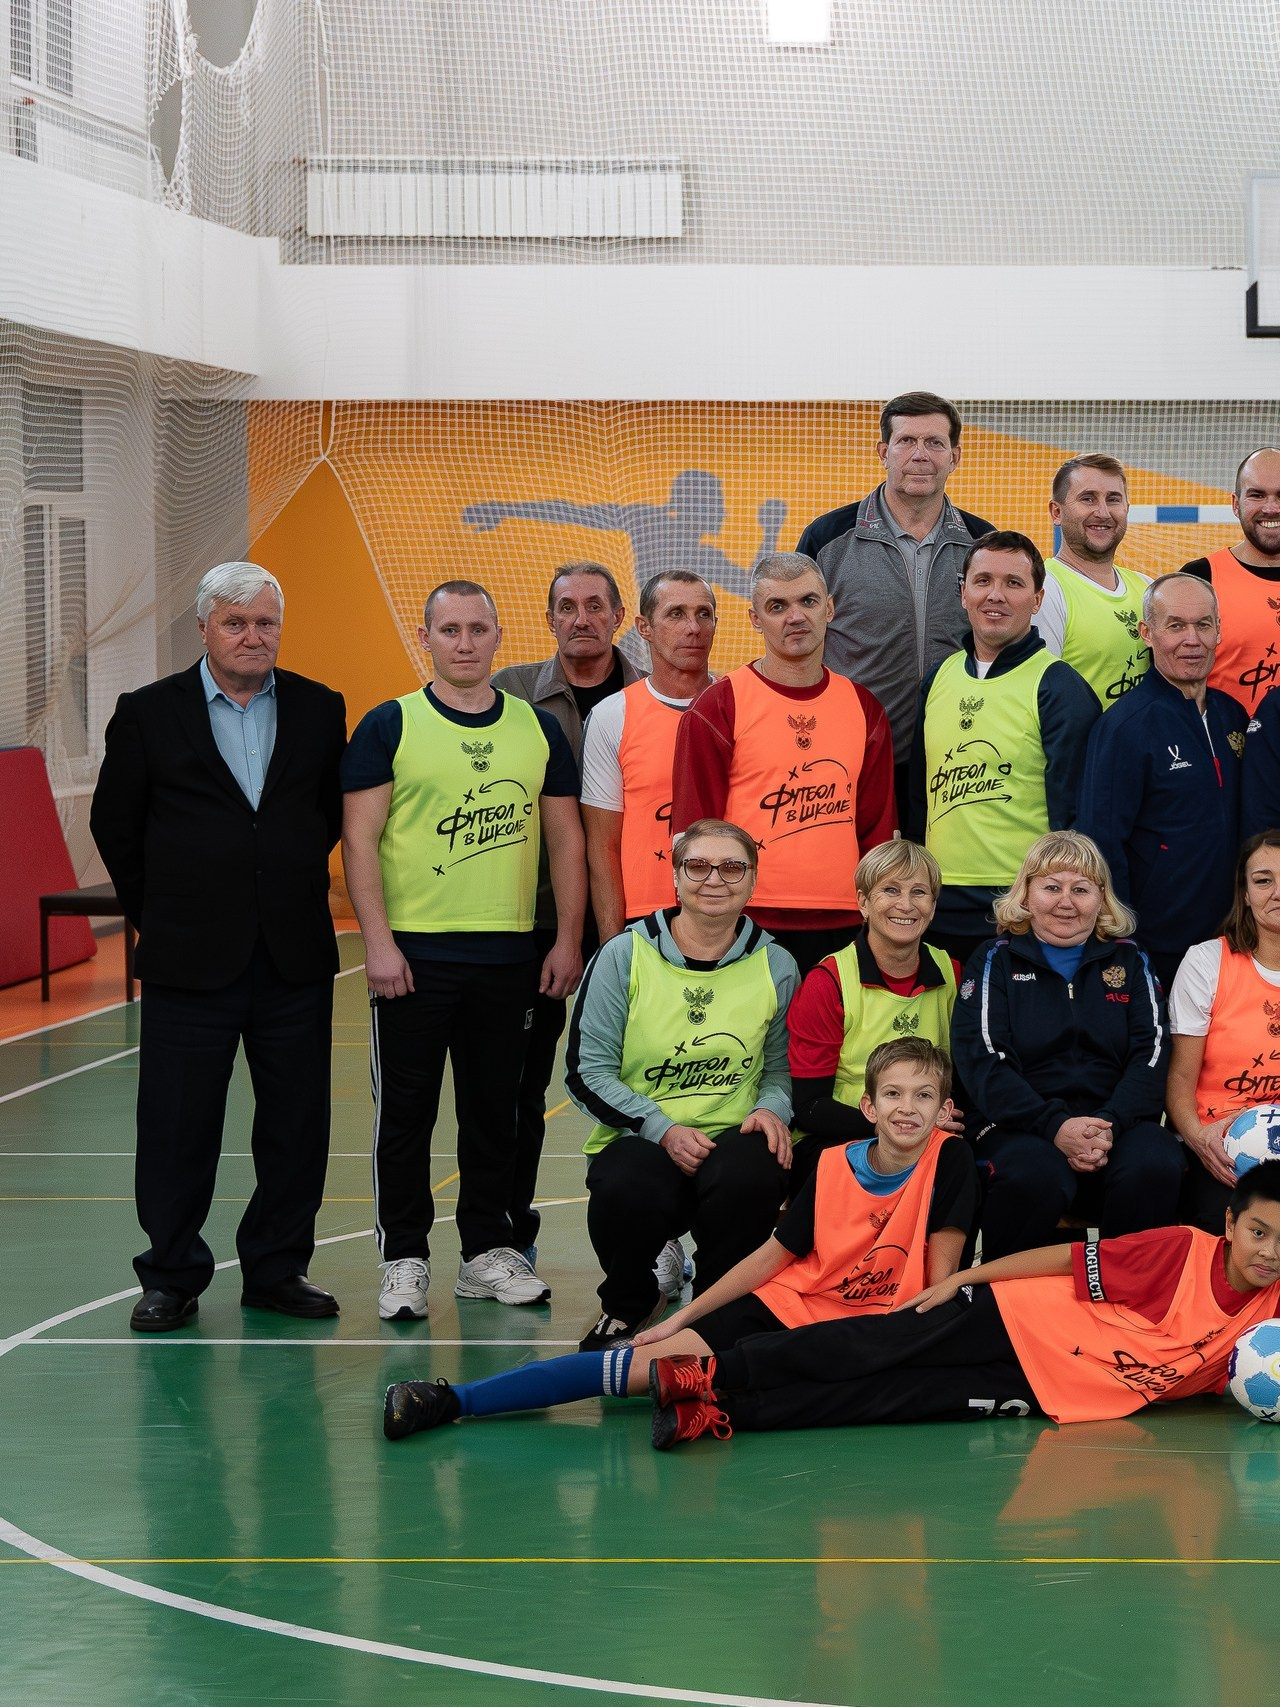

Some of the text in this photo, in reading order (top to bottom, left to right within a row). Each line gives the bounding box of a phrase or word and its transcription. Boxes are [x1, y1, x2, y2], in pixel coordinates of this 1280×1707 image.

[930, 762, 987, 810] ФУТБОЛ
[949, 779, 1005, 802] ШКОЛЕ
[760, 783, 836, 829] ФУТБОЛ
[799, 800, 851, 823] ШКОЛЕ
[436, 803, 515, 853] ФУТБОЛ
[477, 819, 527, 845] ШКОЛЕ
[644, 1057, 730, 1092] ФУТБОЛ
[680, 1072, 744, 1090] ШКОЛЕ
